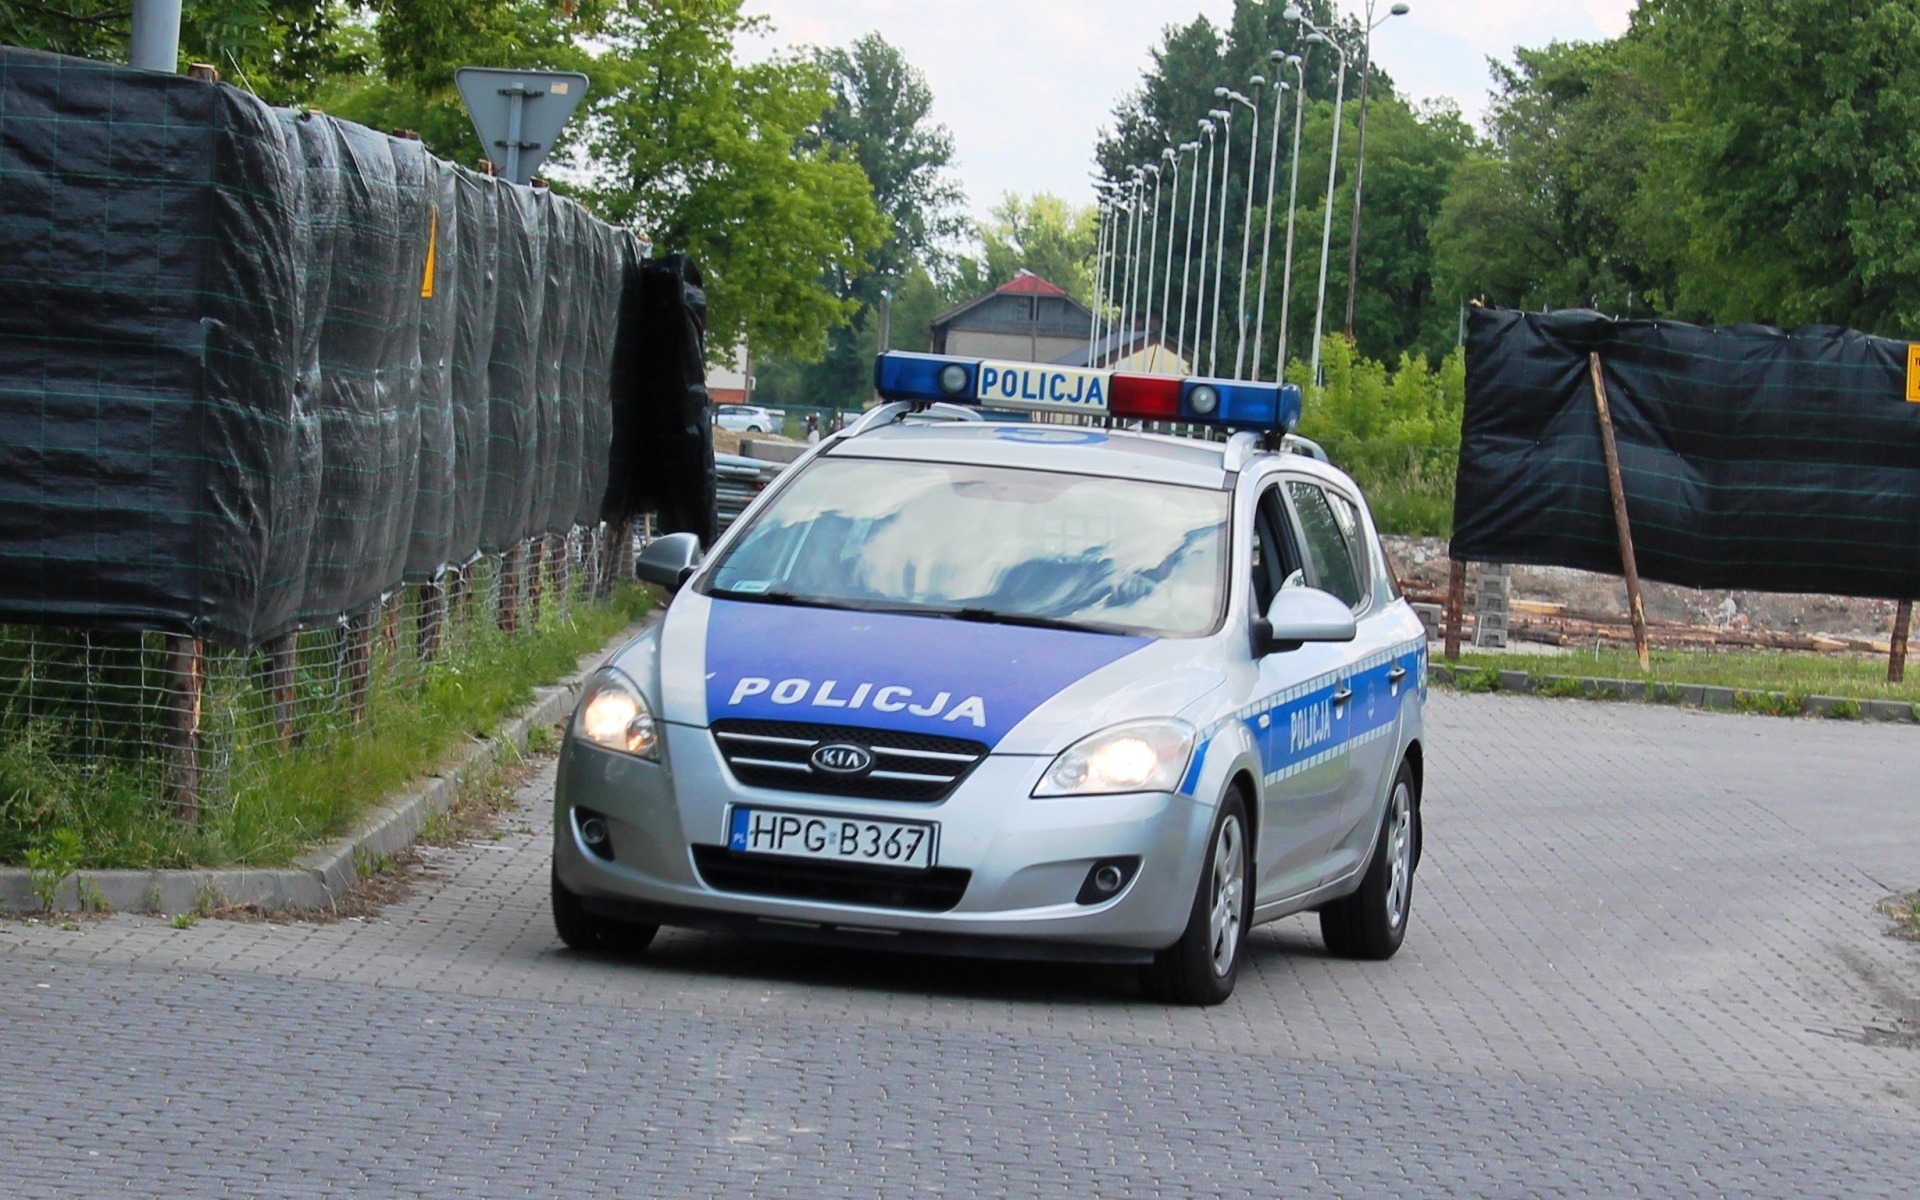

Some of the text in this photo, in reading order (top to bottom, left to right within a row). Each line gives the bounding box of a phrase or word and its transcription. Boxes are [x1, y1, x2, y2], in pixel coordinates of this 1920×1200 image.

[982, 367, 1104, 406] POLICJA
[728, 677, 986, 727] POLICJA
[1290, 698, 1331, 755] POLICJA
[821, 749, 860, 768] KIA
[732, 832, 746, 844] PL
[752, 814, 925, 862] HPG B367
